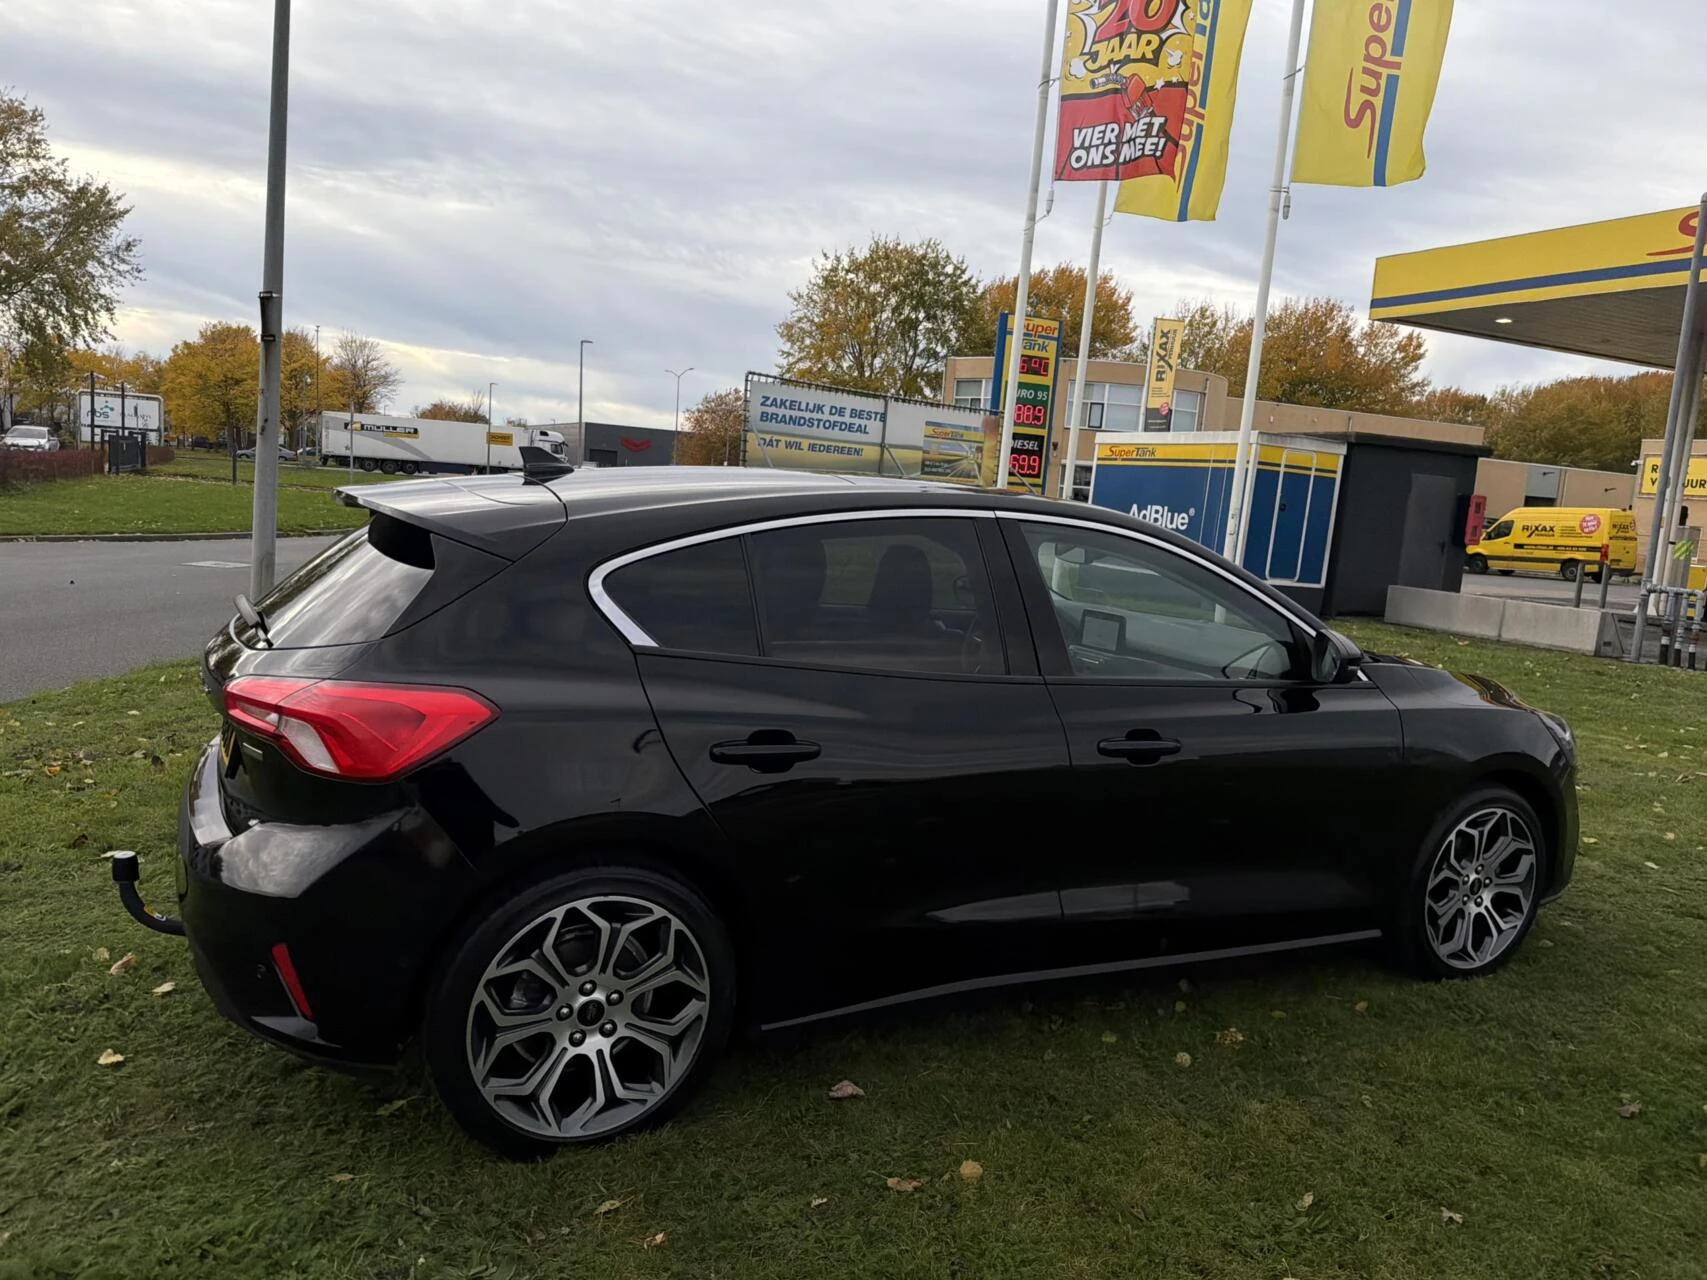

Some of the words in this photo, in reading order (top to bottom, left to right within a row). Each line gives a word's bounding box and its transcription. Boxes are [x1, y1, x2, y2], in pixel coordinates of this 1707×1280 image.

[1083, 33, 1160, 71] JAAR
[1344, 0, 1401, 159] Supe
[1073, 123, 1119, 148] VIER
[1123, 116, 1166, 142] MET
[1070, 144, 1115, 169] ONS
[1119, 137, 1166, 163] MEE!
[1023, 338, 1049, 353] ank
[760, 395, 825, 415] ZAKELIJK
[829, 405, 846, 417] DE
[849, 408, 887, 422] BESTE
[1037, 391, 1048, 401] 95
[760, 411, 869, 434] BRANDSTOFDEAL
[785, 440, 804, 451] WIL
[807, 442, 864, 456] IEDEREEN!
